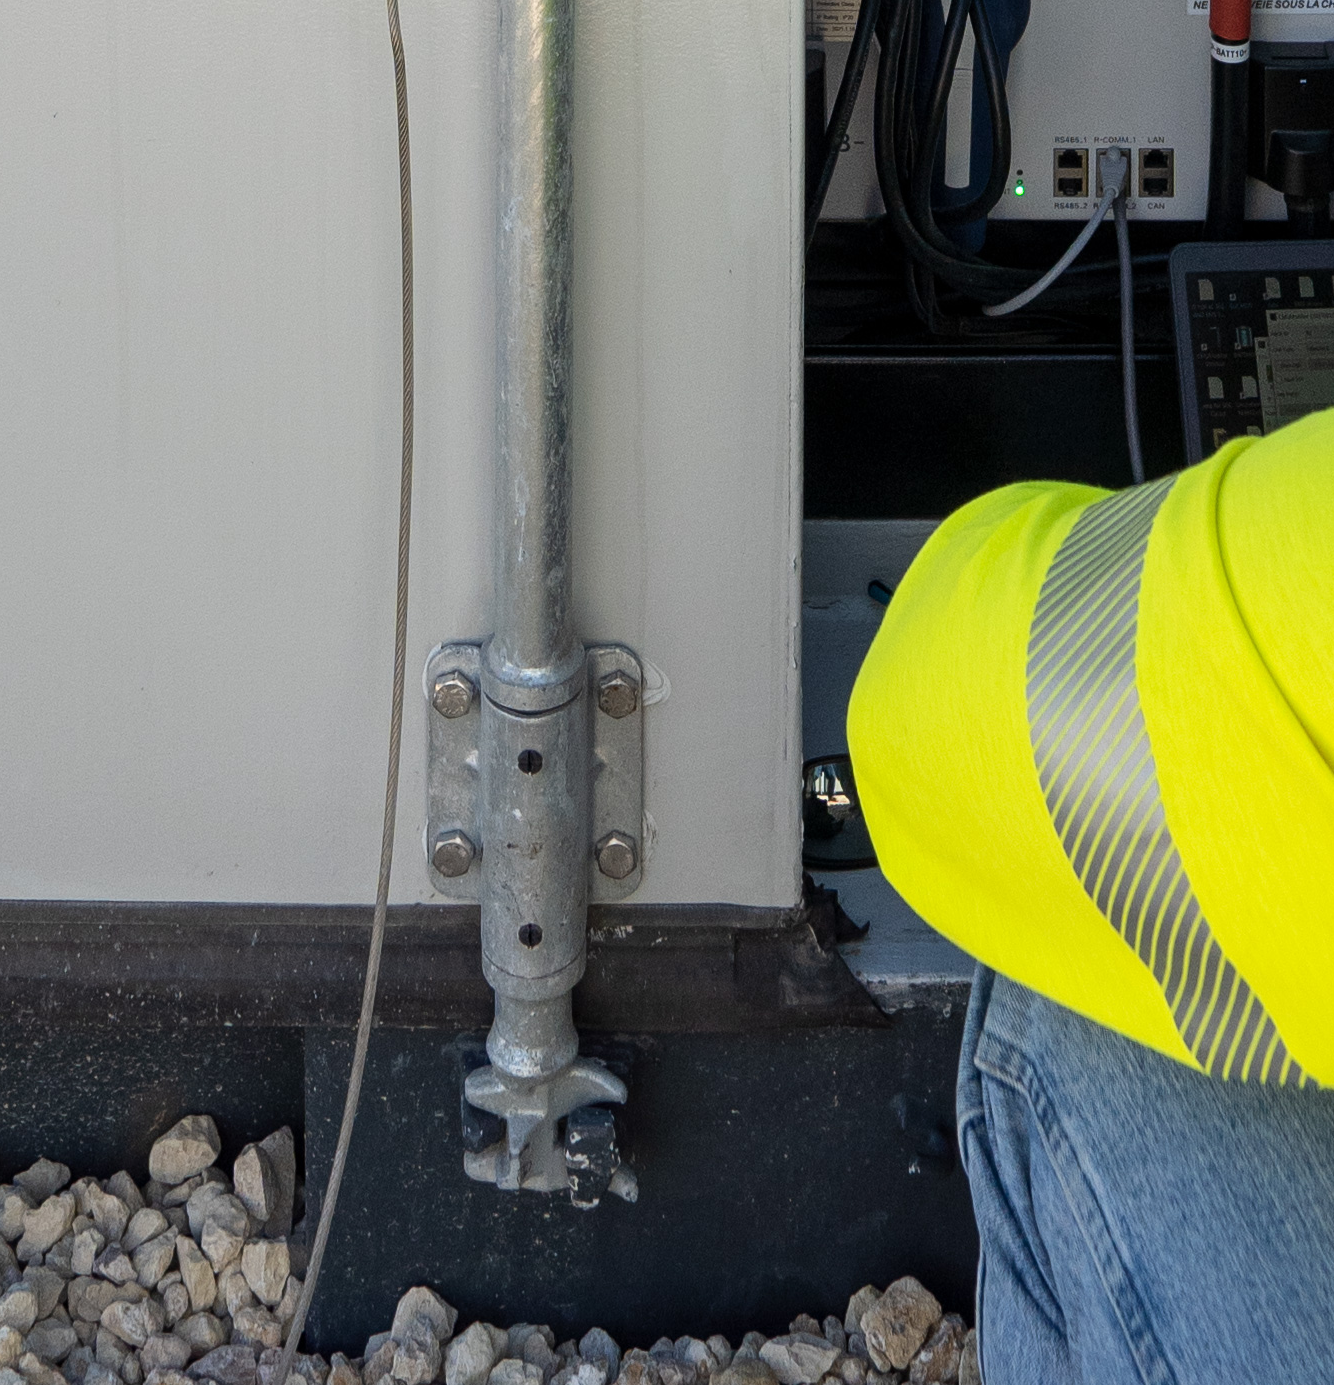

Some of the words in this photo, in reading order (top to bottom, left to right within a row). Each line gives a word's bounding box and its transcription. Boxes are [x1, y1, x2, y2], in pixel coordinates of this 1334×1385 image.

[1193, 0, 1208, 10] NE
[1274, 0, 1305, 9] SOUS
[1306, 0, 1319, 9] LA
[1147, 202, 1165, 210] CAN
